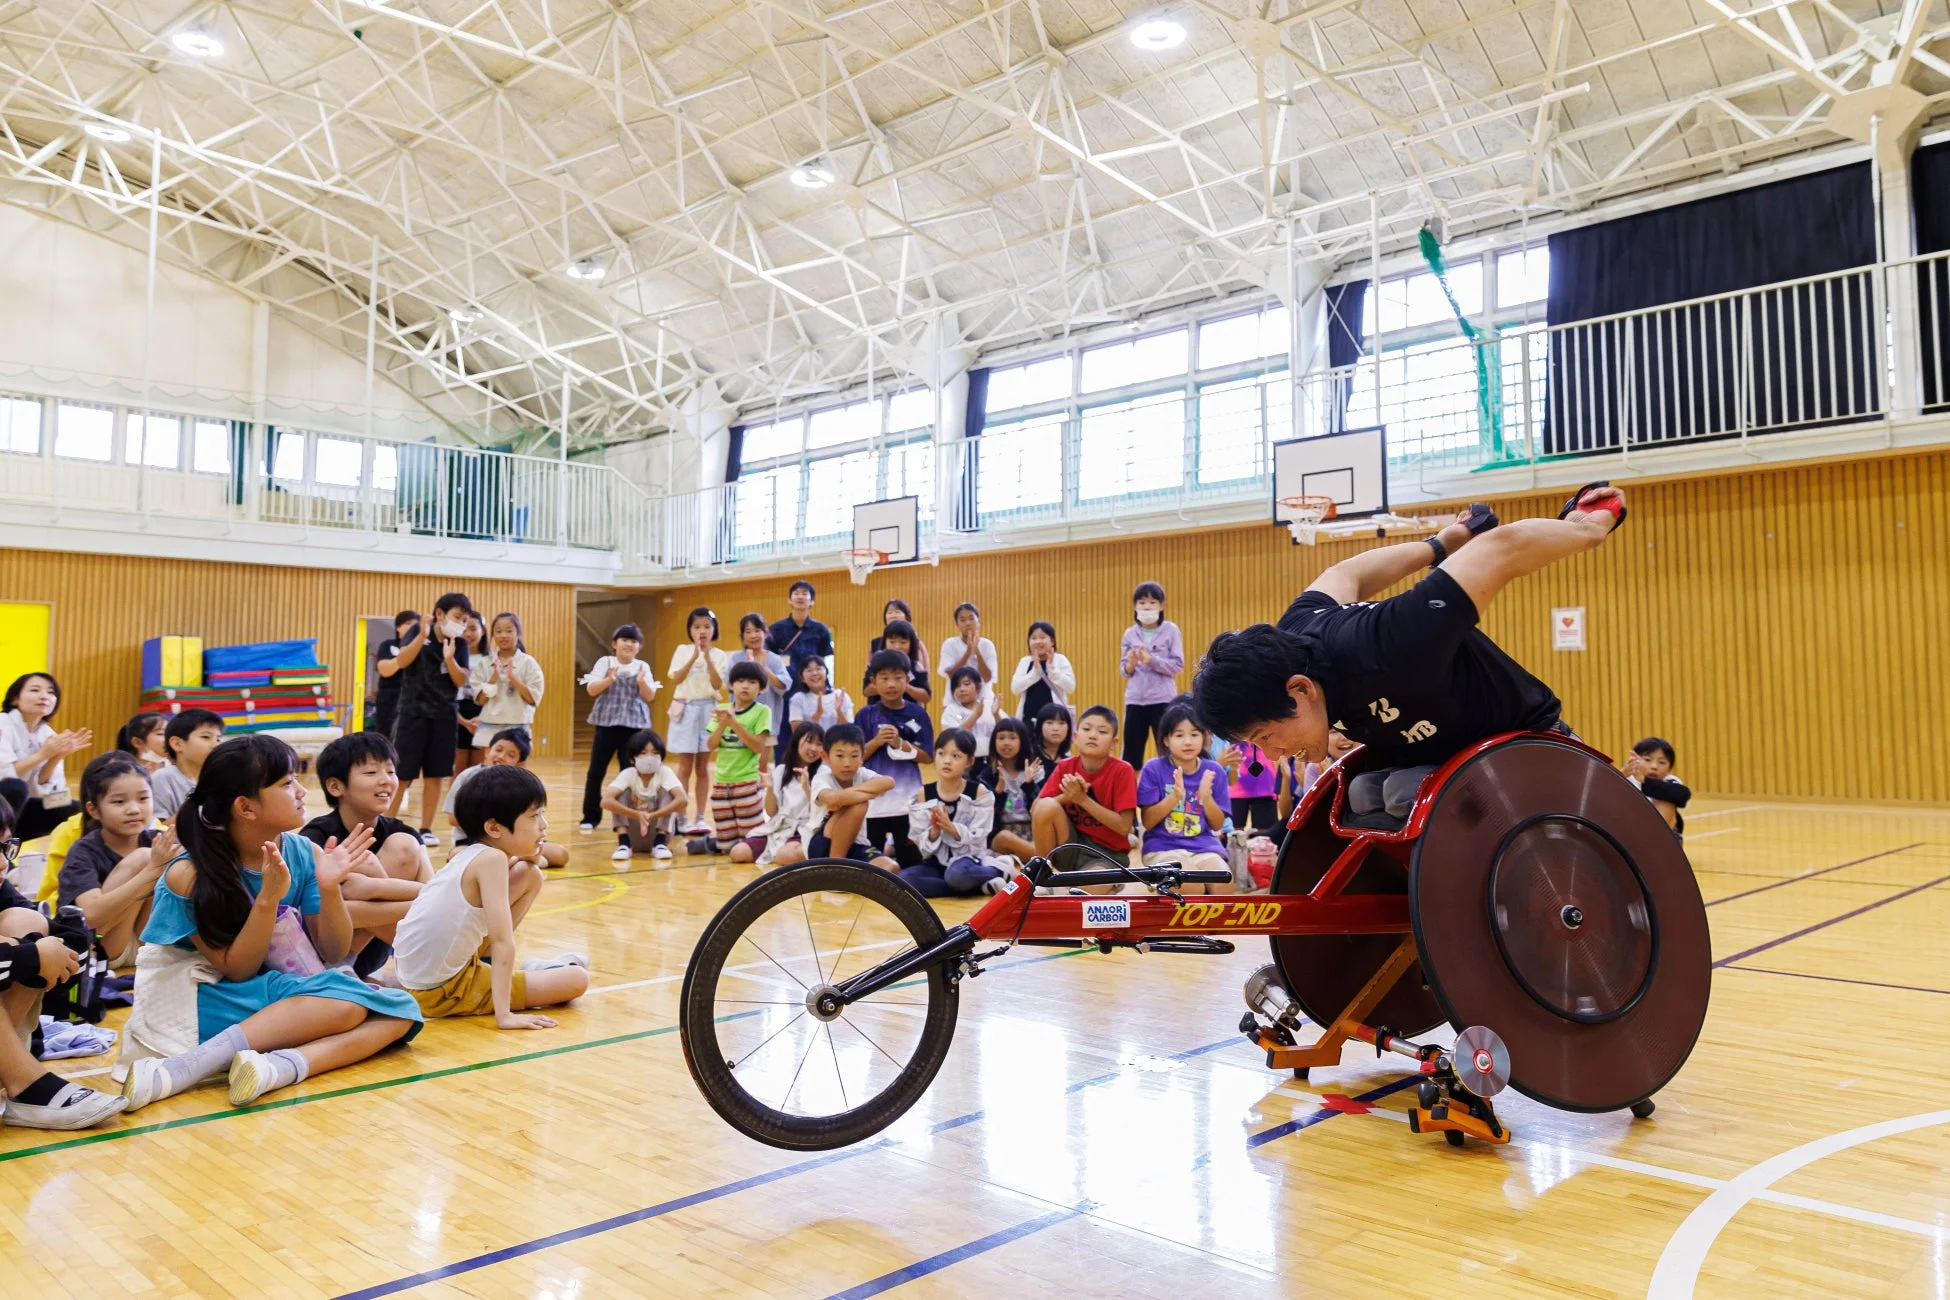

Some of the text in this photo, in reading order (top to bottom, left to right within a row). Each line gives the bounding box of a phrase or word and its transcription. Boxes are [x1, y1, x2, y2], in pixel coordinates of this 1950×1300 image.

[1088, 913, 1127, 922] CARBON
[1168, 902, 1282, 927] TOP END
